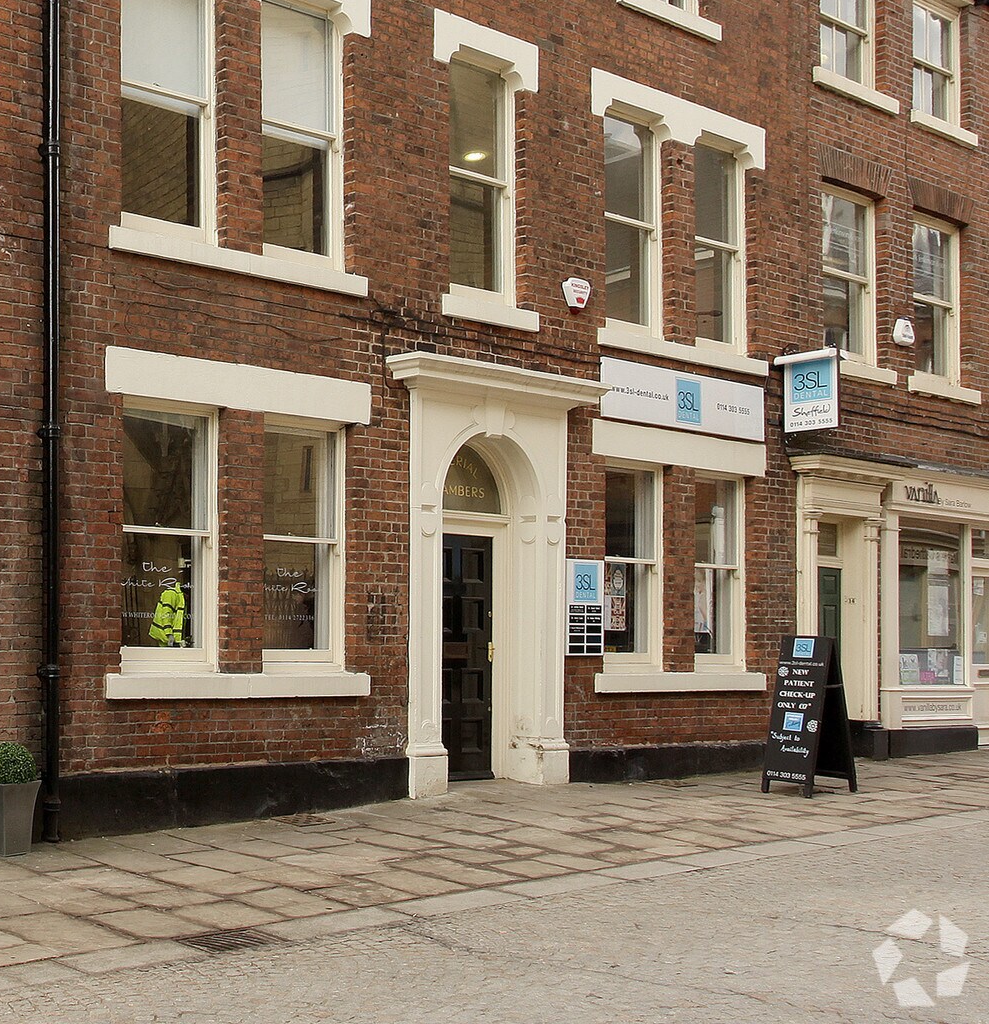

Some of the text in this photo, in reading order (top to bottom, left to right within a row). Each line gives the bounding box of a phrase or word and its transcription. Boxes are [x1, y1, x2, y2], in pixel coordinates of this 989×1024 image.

[794, 371, 828, 391] 3SL
[794, 390, 828, 400] DENTAL
[678, 391, 699, 412] 3SL
[716, 402, 728, 411] 0114
[728, 405, 738, 413] 303
[738, 406, 750, 416] 5555
[792, 404, 830, 418] Sheffield
[444, 485, 485, 498] AMBERS
[142, 562, 172, 572] the
[277, 568, 304, 578] the
[121, 577, 156, 588] hite
[576, 574, 596, 590] 3SL
[796, 644, 811, 652] 3SL
[779, 690, 816, 698] CHECK-UP
